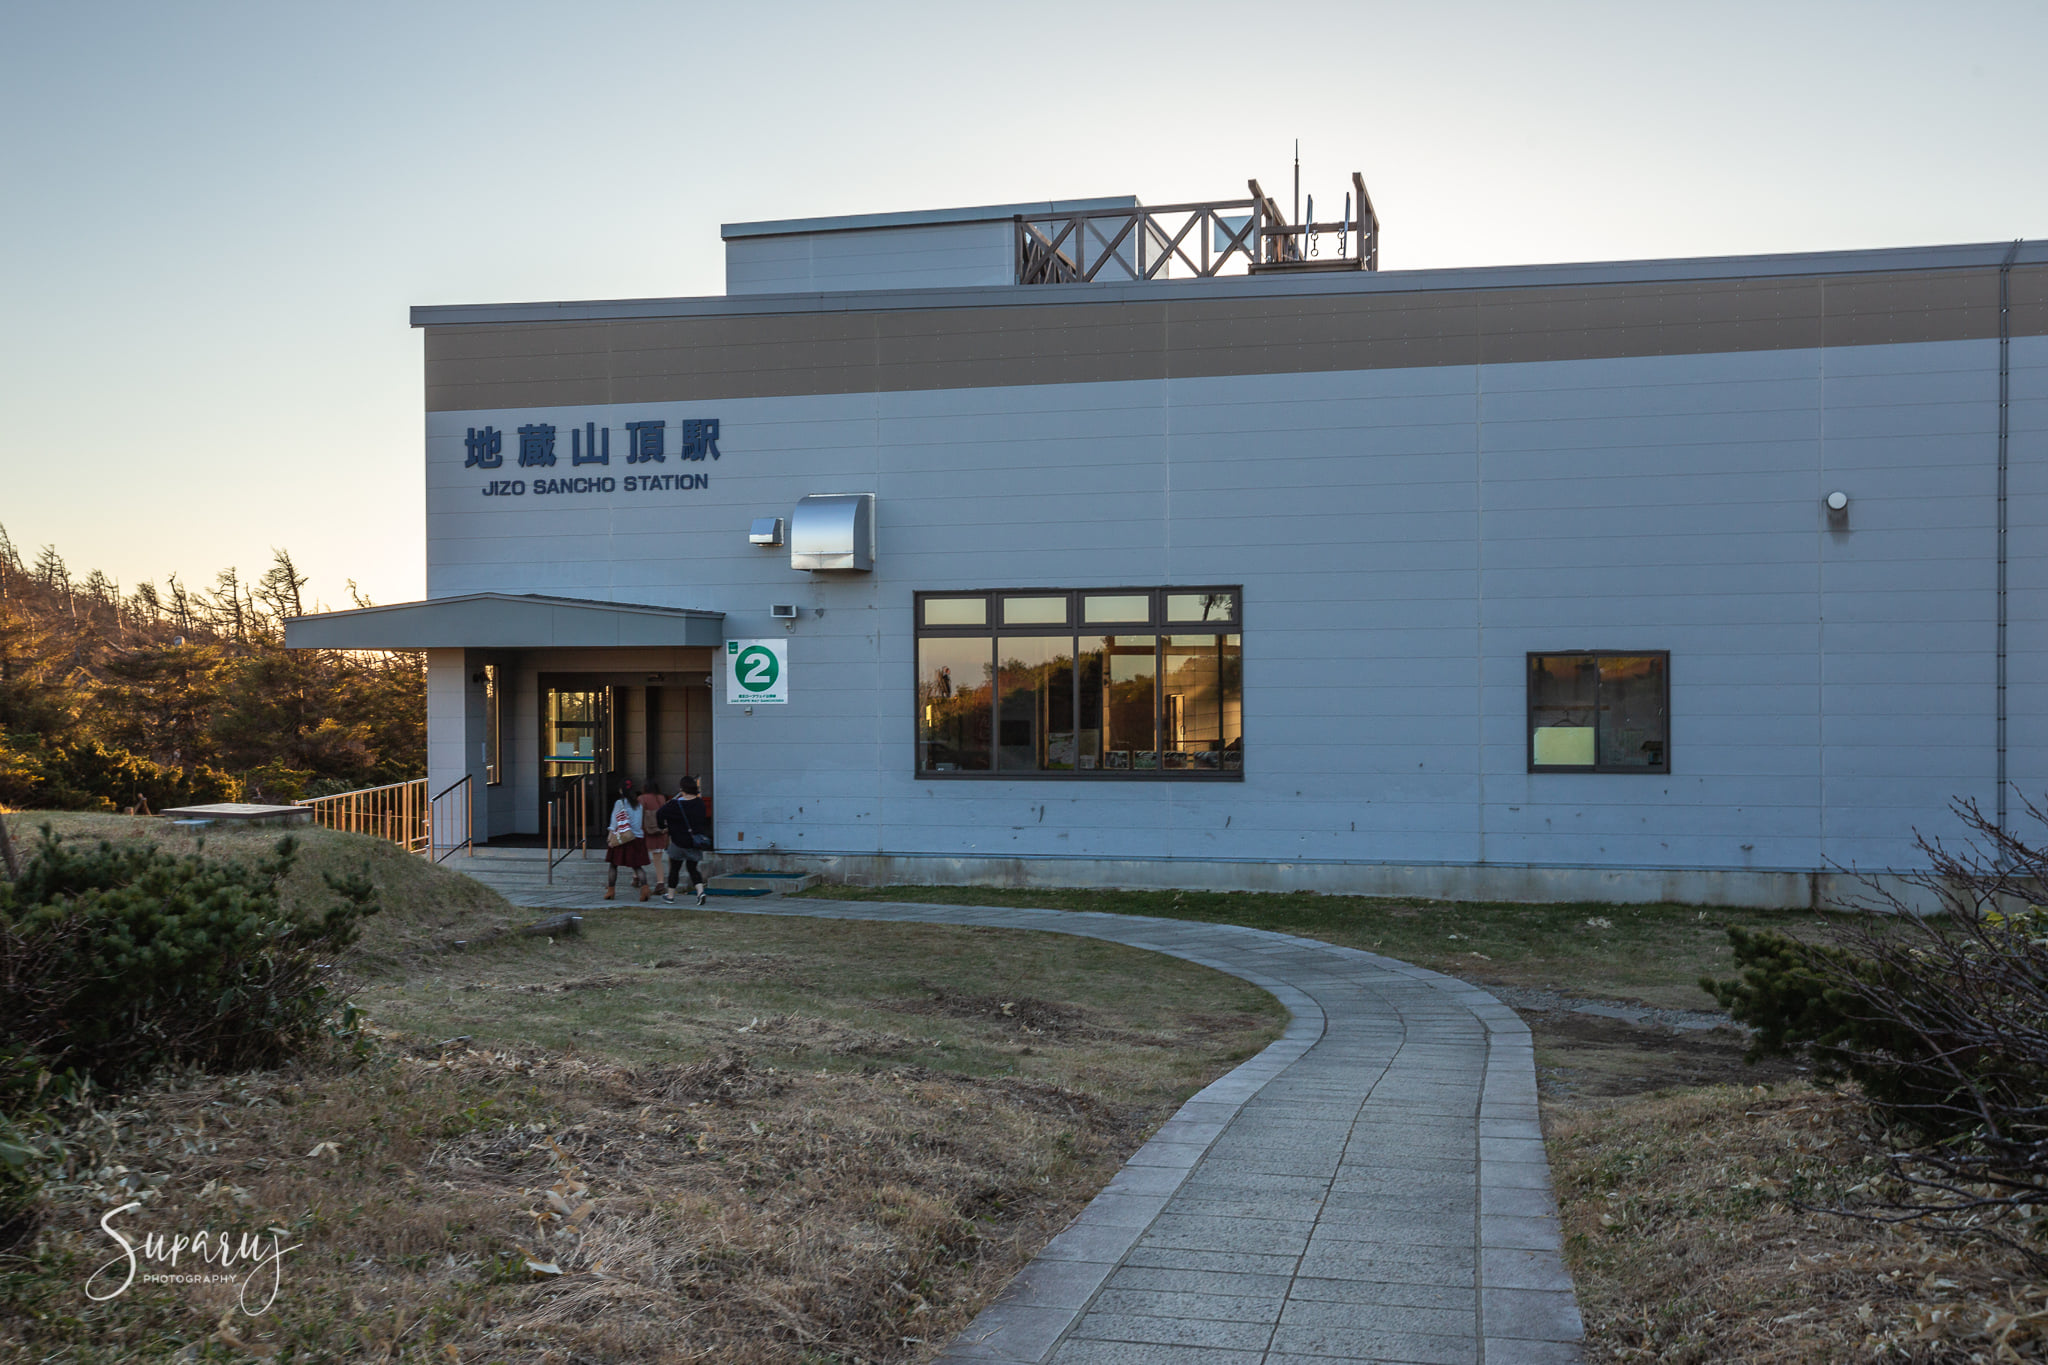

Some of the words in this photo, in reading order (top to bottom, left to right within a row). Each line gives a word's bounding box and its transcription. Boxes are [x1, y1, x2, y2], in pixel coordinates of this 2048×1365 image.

[464, 418, 721, 469] 地蔵山頂駅
[482, 480, 525, 496] JIZO
[533, 477, 615, 495] SANCHO
[624, 473, 708, 491] STATION
[744, 652, 771, 684] 2
